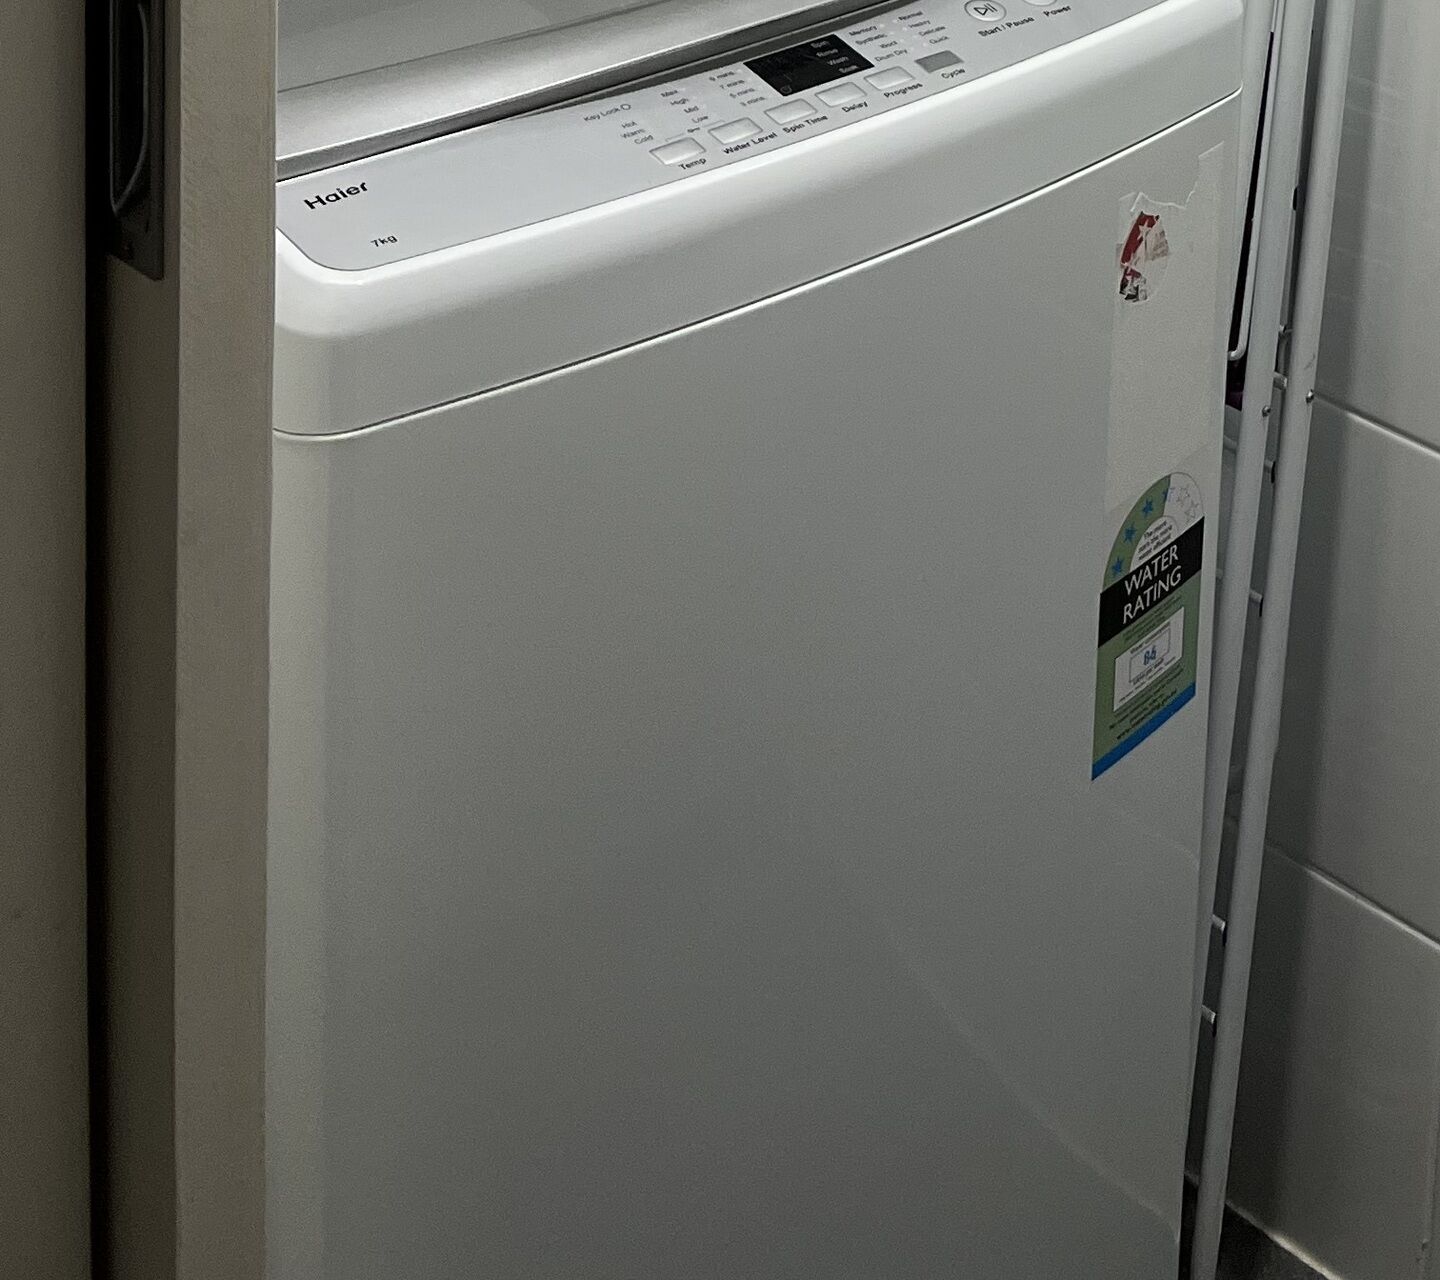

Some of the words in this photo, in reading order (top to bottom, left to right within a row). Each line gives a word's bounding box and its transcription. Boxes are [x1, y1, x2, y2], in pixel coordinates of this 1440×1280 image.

[1043, 6, 1071, 17] Power
[978, 26, 1002, 37] Start
[1005, 16, 1035, 29] Pause
[929, 36, 949, 44] Quick
[941, 68, 965, 79] Cycle
[670, 98, 689, 106] High
[842, 101, 868, 112] Delay
[583, 113, 601, 122] Key
[600, 107, 620, 117] Lock
[684, 106, 699, 114] Mid
[621, 121, 637, 129] Hot
[691, 115, 709, 124] Low
[782, 123, 805, 133] Spin
[804, 115, 828, 125] Time
[634, 134, 654, 144] Cold
[723, 142, 751, 155] Water
[750, 132, 778, 145] Level
[678, 158, 707, 170] Temp
[304, 182, 368, 210] Haier
[370, 235, 398, 247] 7kg
[1124, 544, 1179, 596] WATER
[1123, 565, 1182, 625] RATING
